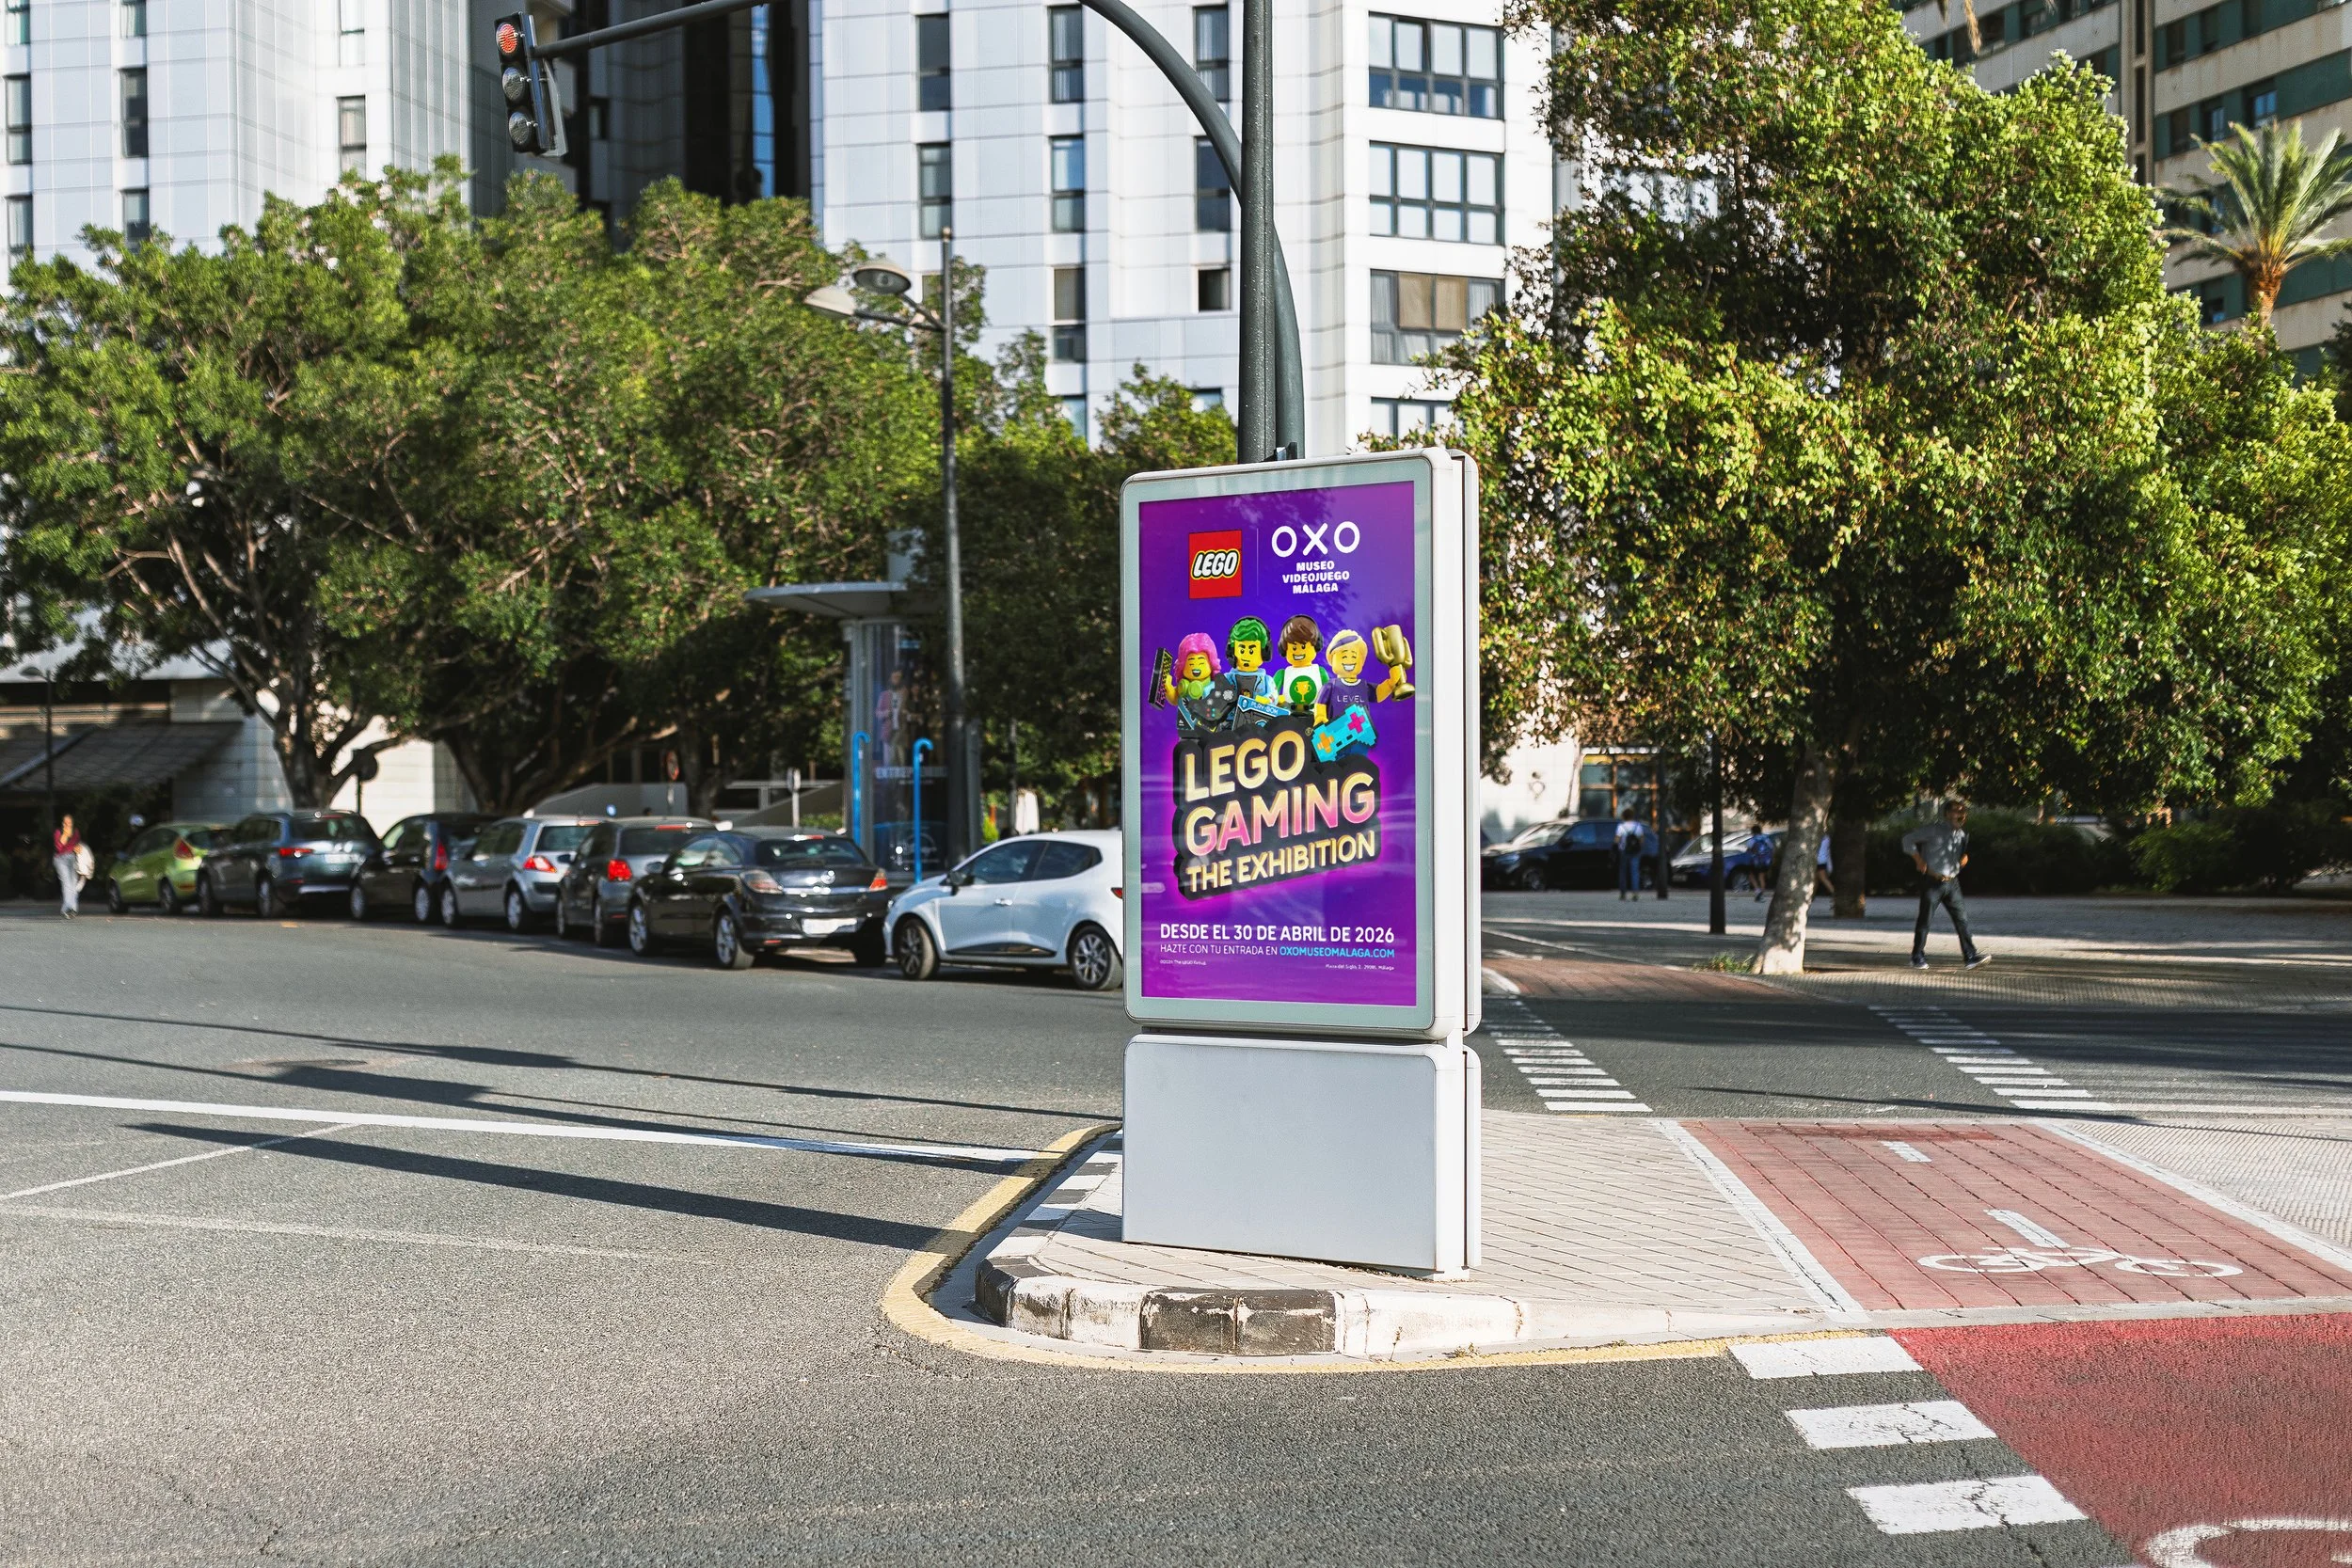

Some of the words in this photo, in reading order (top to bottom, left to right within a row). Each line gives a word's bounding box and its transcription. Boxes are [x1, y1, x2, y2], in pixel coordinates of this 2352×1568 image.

[1271, 521, 1360, 558] OXO
[1192, 550, 1239, 579] LEGO
[1295, 561, 1335, 572] MUSEO
[1282, 571, 1350, 583] VIDEOJUEGO
[1292, 582, 1339, 594] MÁLAGA
[1336, 694, 1365, 703] LEVEL
[1184, 730, 1306, 802] LEGO
[1184, 771, 1376, 857] GAMING
[1185, 858, 1233, 893] THE
[1237, 830, 1376, 883] EXHIBITION
[1160, 924, 1209, 940] DESDE
[1213, 925, 1230, 940] EL
[1233, 925, 1252, 941] 30
[1257, 926, 1277, 941] DE
[1279, 926, 1327, 942] ABRIL
[1330, 927, 1351, 942] DE
[1355, 927, 1395, 943] 2026
[1160, 943, 1187, 954] HAZTE
[1188, 944, 1208, 954] CON
[1210, 944, 1221, 954] TU
[1223, 944, 1263, 955] ENTRADA
[1265, 945, 1278, 956] EN
[1279, 946, 1395, 958] OXOMUSEOMALAGA.COM
